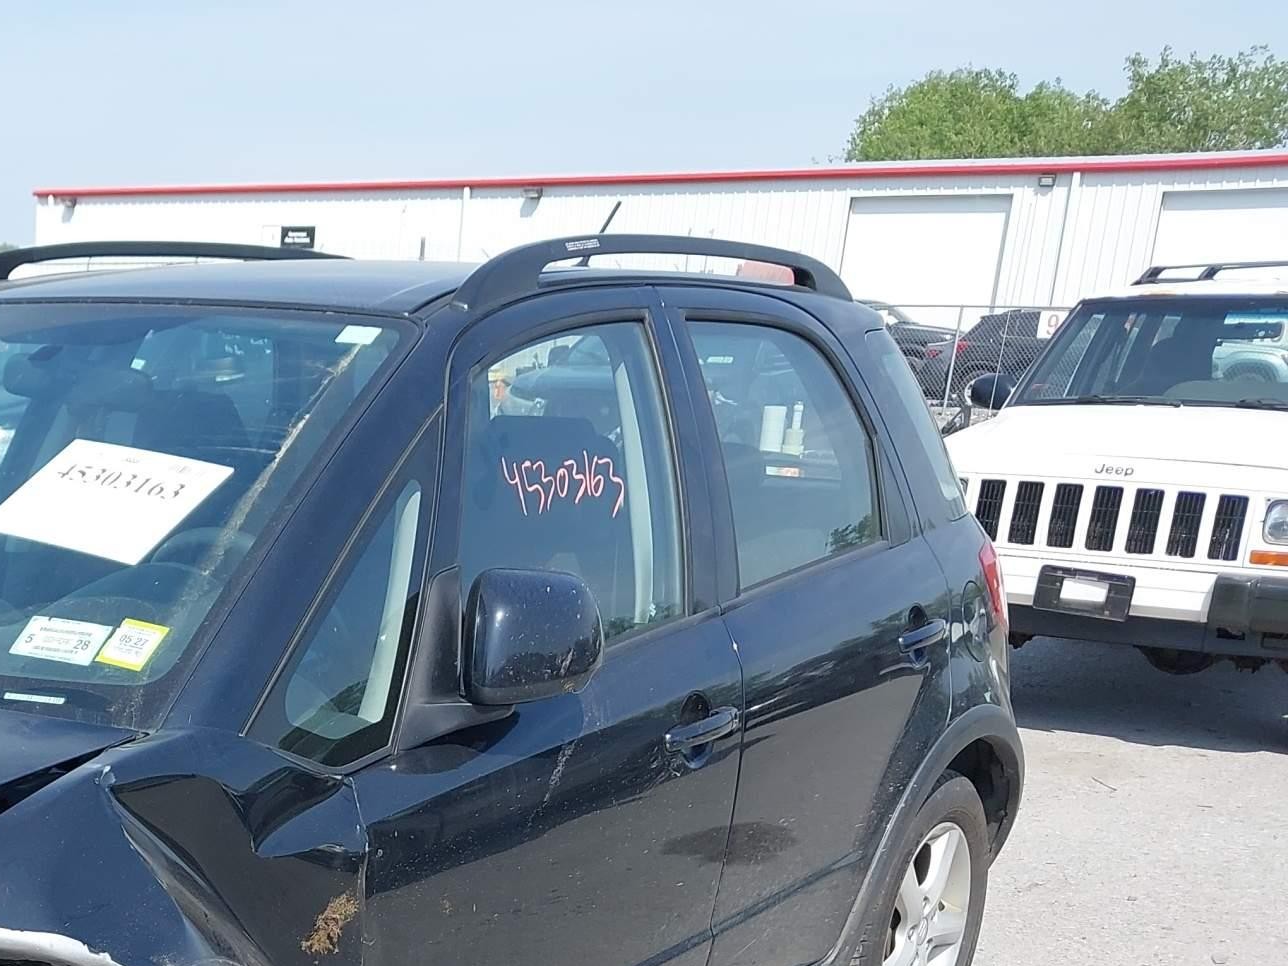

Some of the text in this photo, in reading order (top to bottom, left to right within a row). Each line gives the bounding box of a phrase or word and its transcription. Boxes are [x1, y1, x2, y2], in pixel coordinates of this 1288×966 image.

[1094, 463, 1135, 477] Jeep
[57, 463, 187, 500] 45303163
[501, 450, 626, 519] 45303163
[24, 632, 35, 645] 5
[72, 638, 92, 651] 28
[118, 633, 150, 648] 05 27
